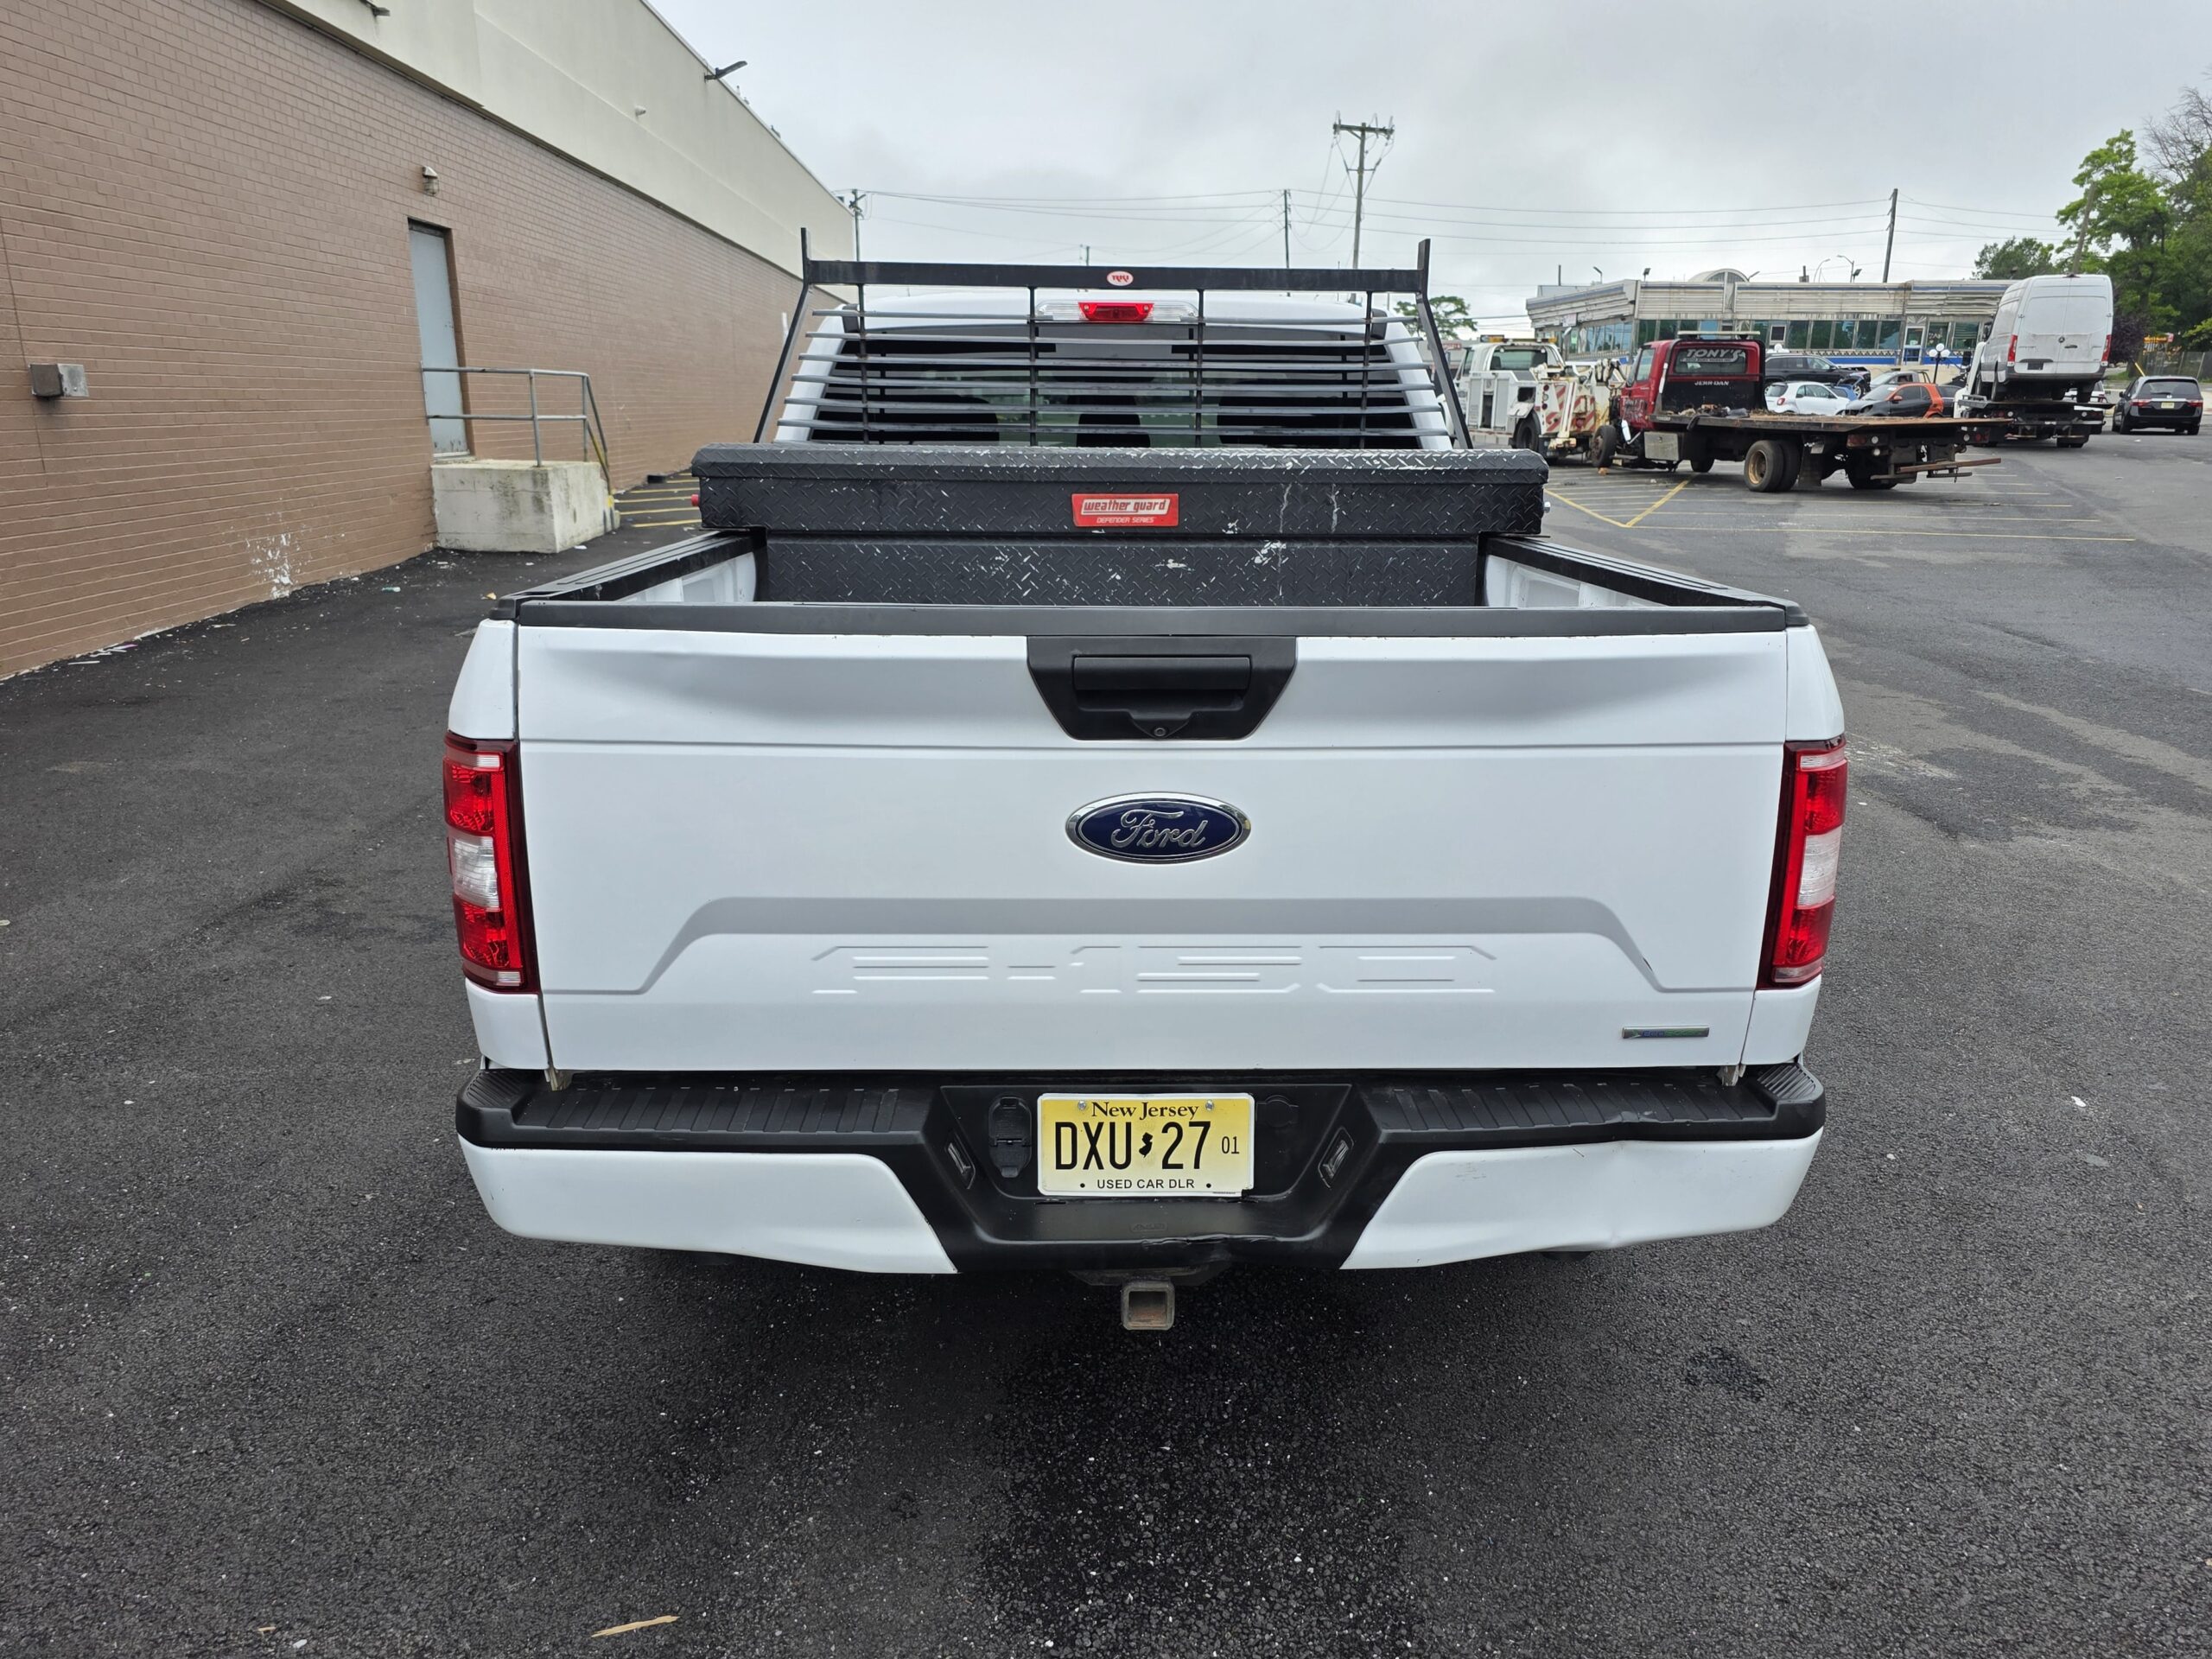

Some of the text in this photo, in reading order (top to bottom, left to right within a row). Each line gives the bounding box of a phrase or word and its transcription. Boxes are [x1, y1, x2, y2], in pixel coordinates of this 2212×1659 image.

[1686, 348, 1743, 362] TONY'S
[1084, 499, 1166, 512] weather guard
[1110, 809, 1209, 848] Ford
[1092, 1102, 1199, 1120] New Jersey
[1055, 1121, 1211, 1170] DXU 27
[1221, 1136, 1240, 1154] 01
[1097, 1179, 1195, 1189] USED CAR DLR
